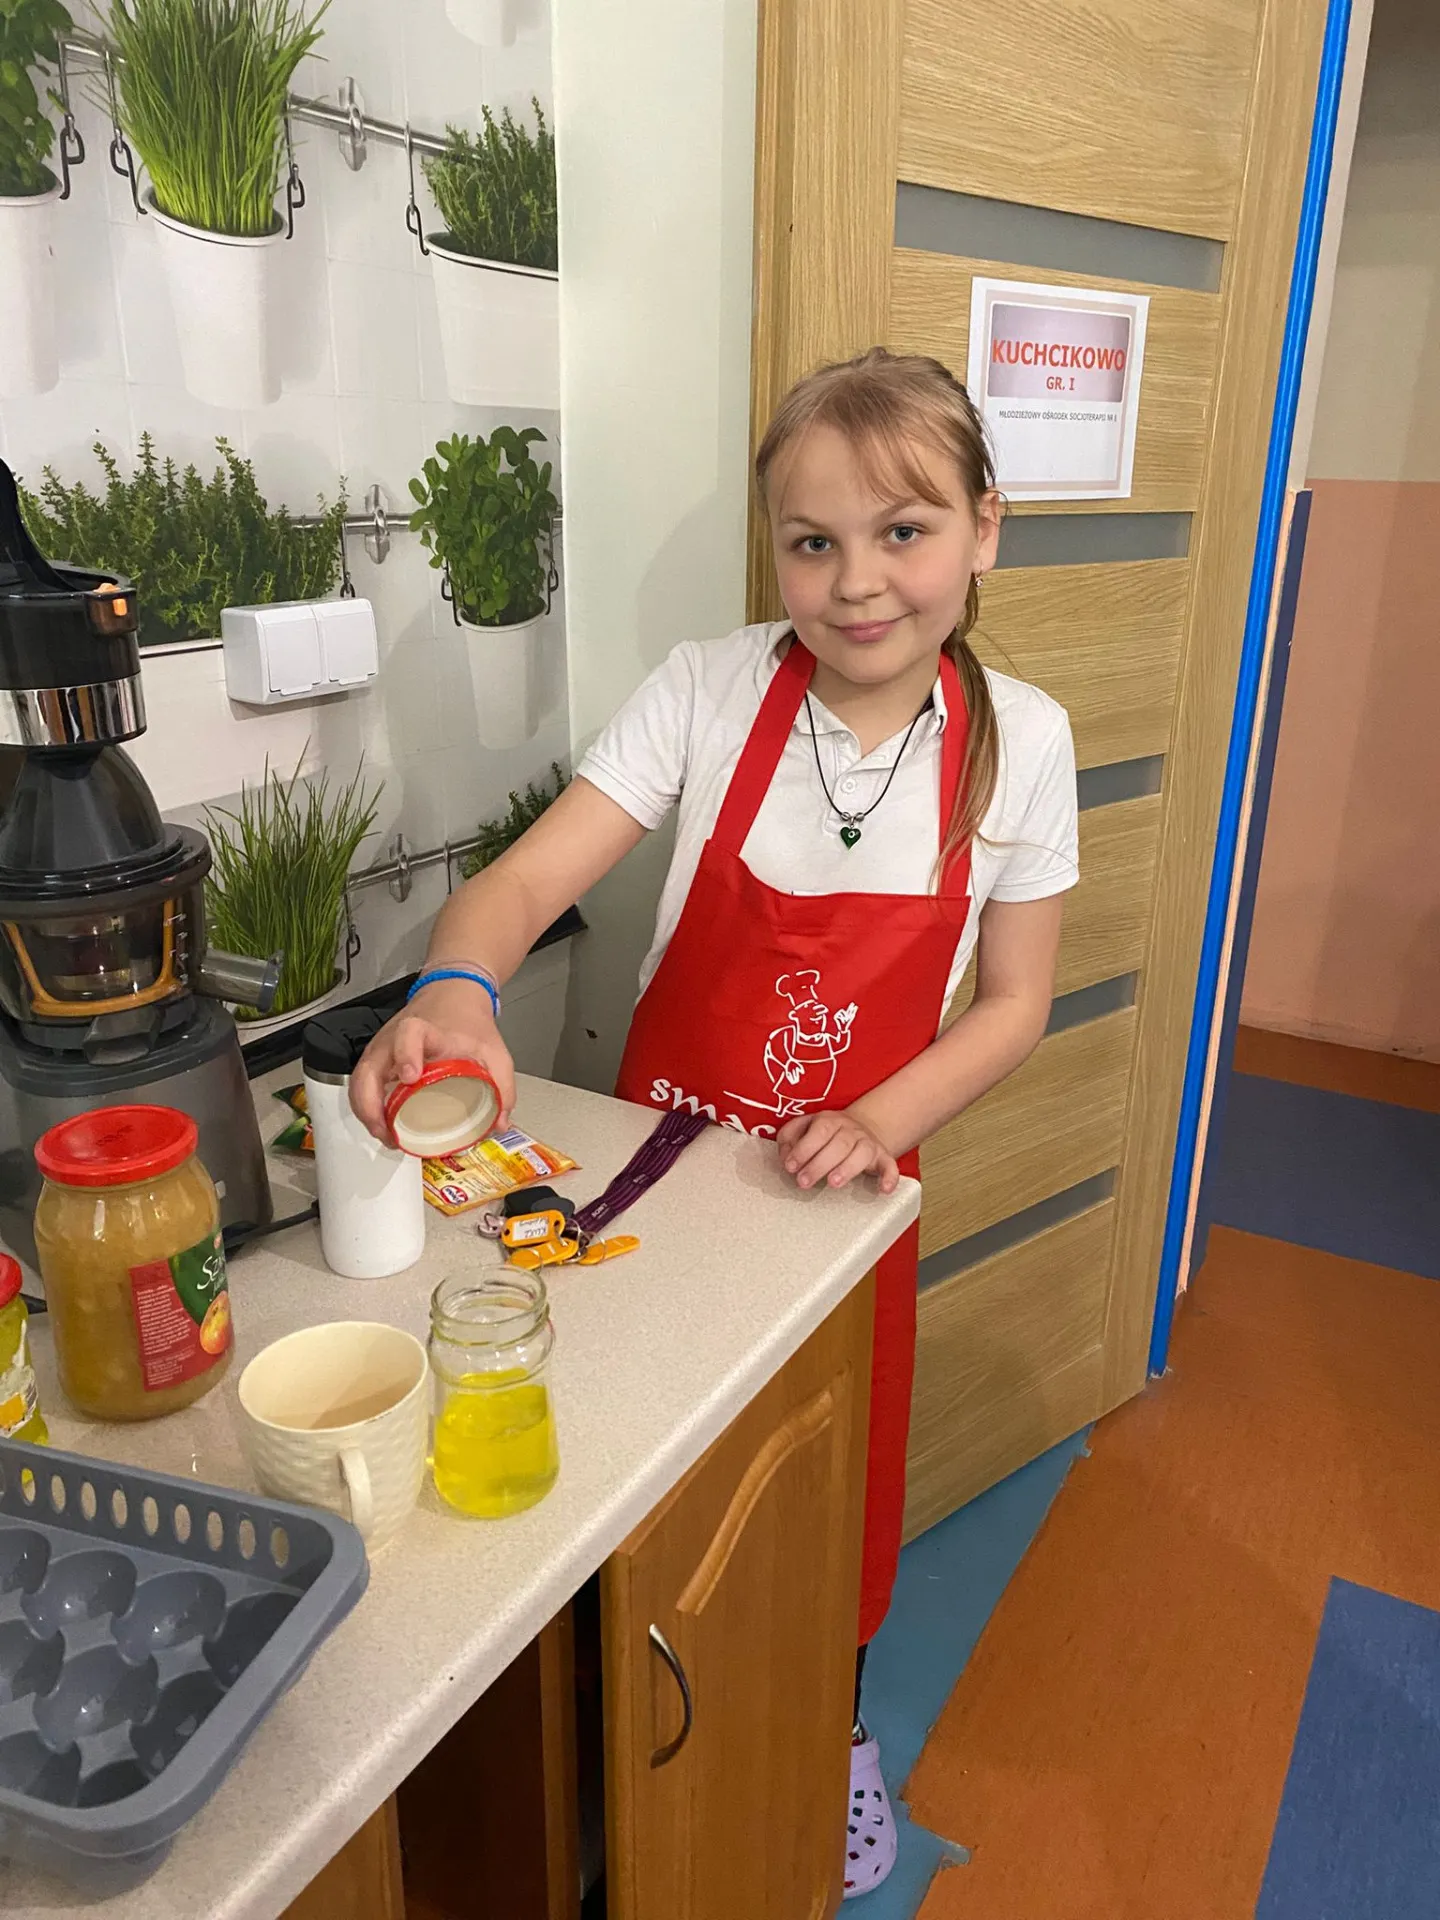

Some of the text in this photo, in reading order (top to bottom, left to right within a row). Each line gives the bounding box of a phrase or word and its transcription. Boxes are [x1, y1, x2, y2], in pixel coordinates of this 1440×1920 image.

[991, 338, 1127, 371] KUCHCIKOWO
[1046, 376, 1075, 391] GR. I
[1042, 410, 1068, 420] OŚRODEK
